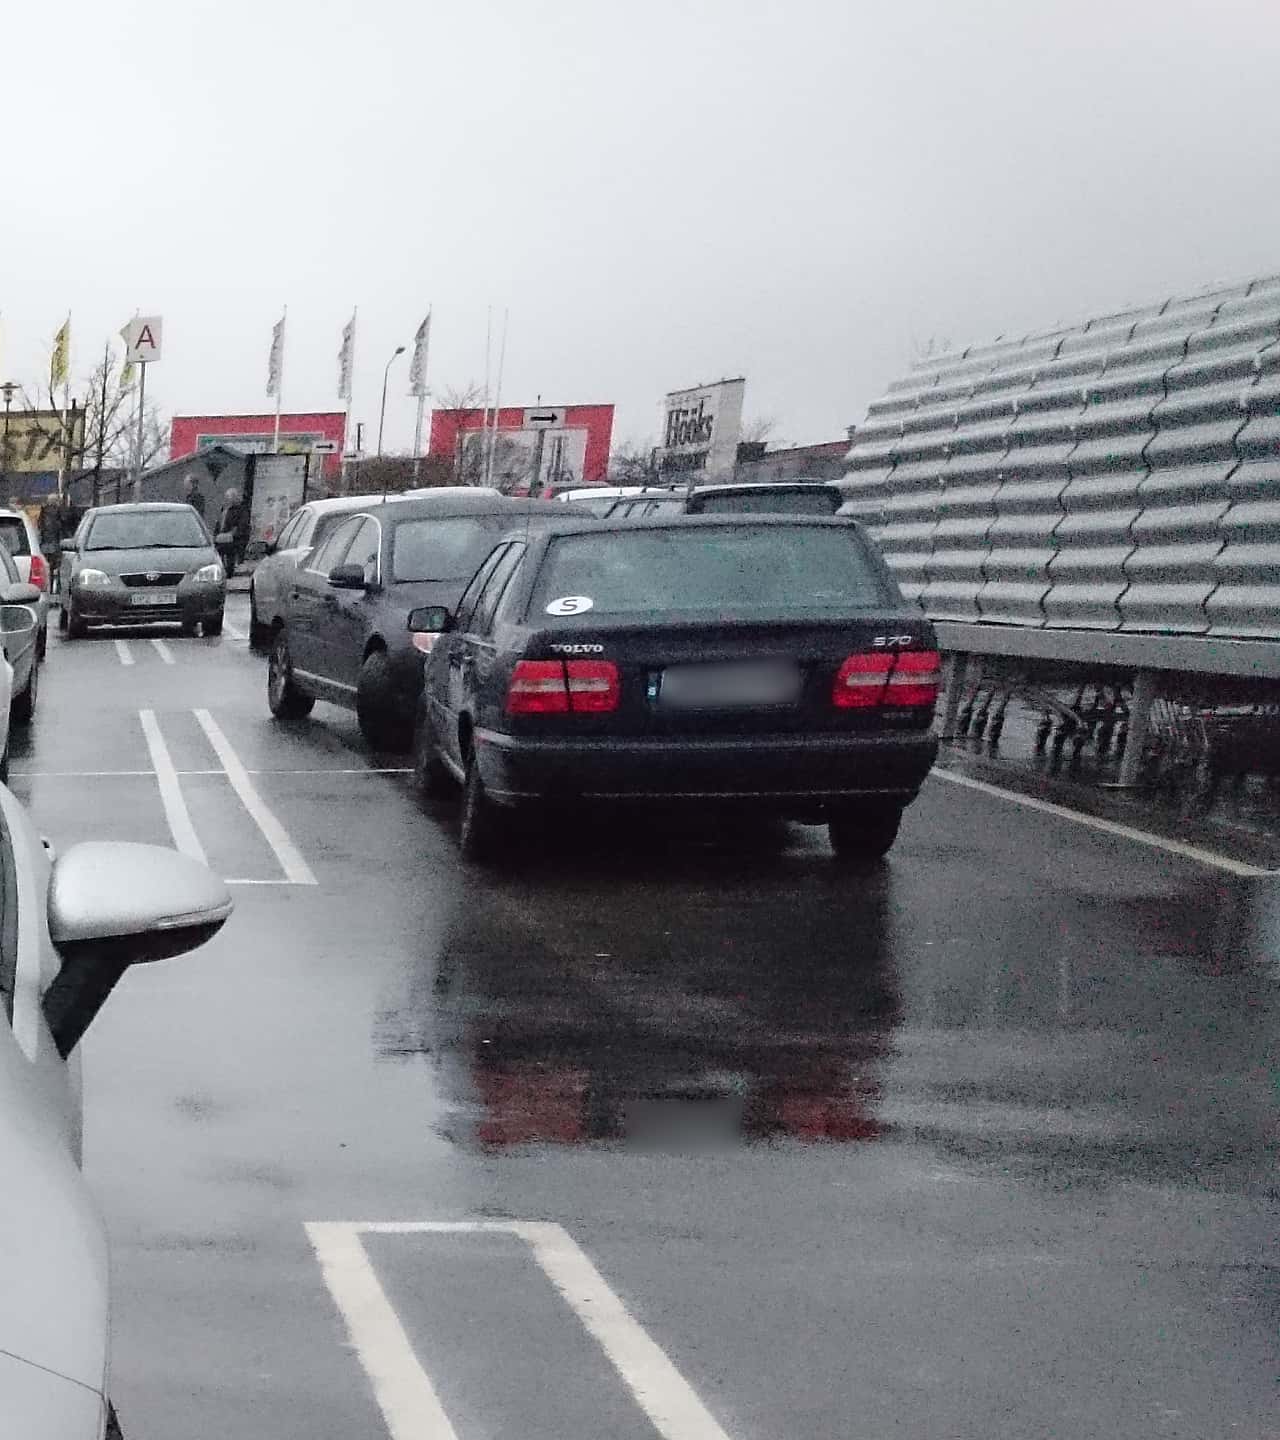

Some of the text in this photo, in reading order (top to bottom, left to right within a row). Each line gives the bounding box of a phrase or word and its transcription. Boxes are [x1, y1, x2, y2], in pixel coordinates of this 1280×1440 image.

[135, 324, 156, 350] A
[559, 599, 578, 612] S
[873, 635, 912, 647] S70
[550, 644, 605, 654] VOLVO
